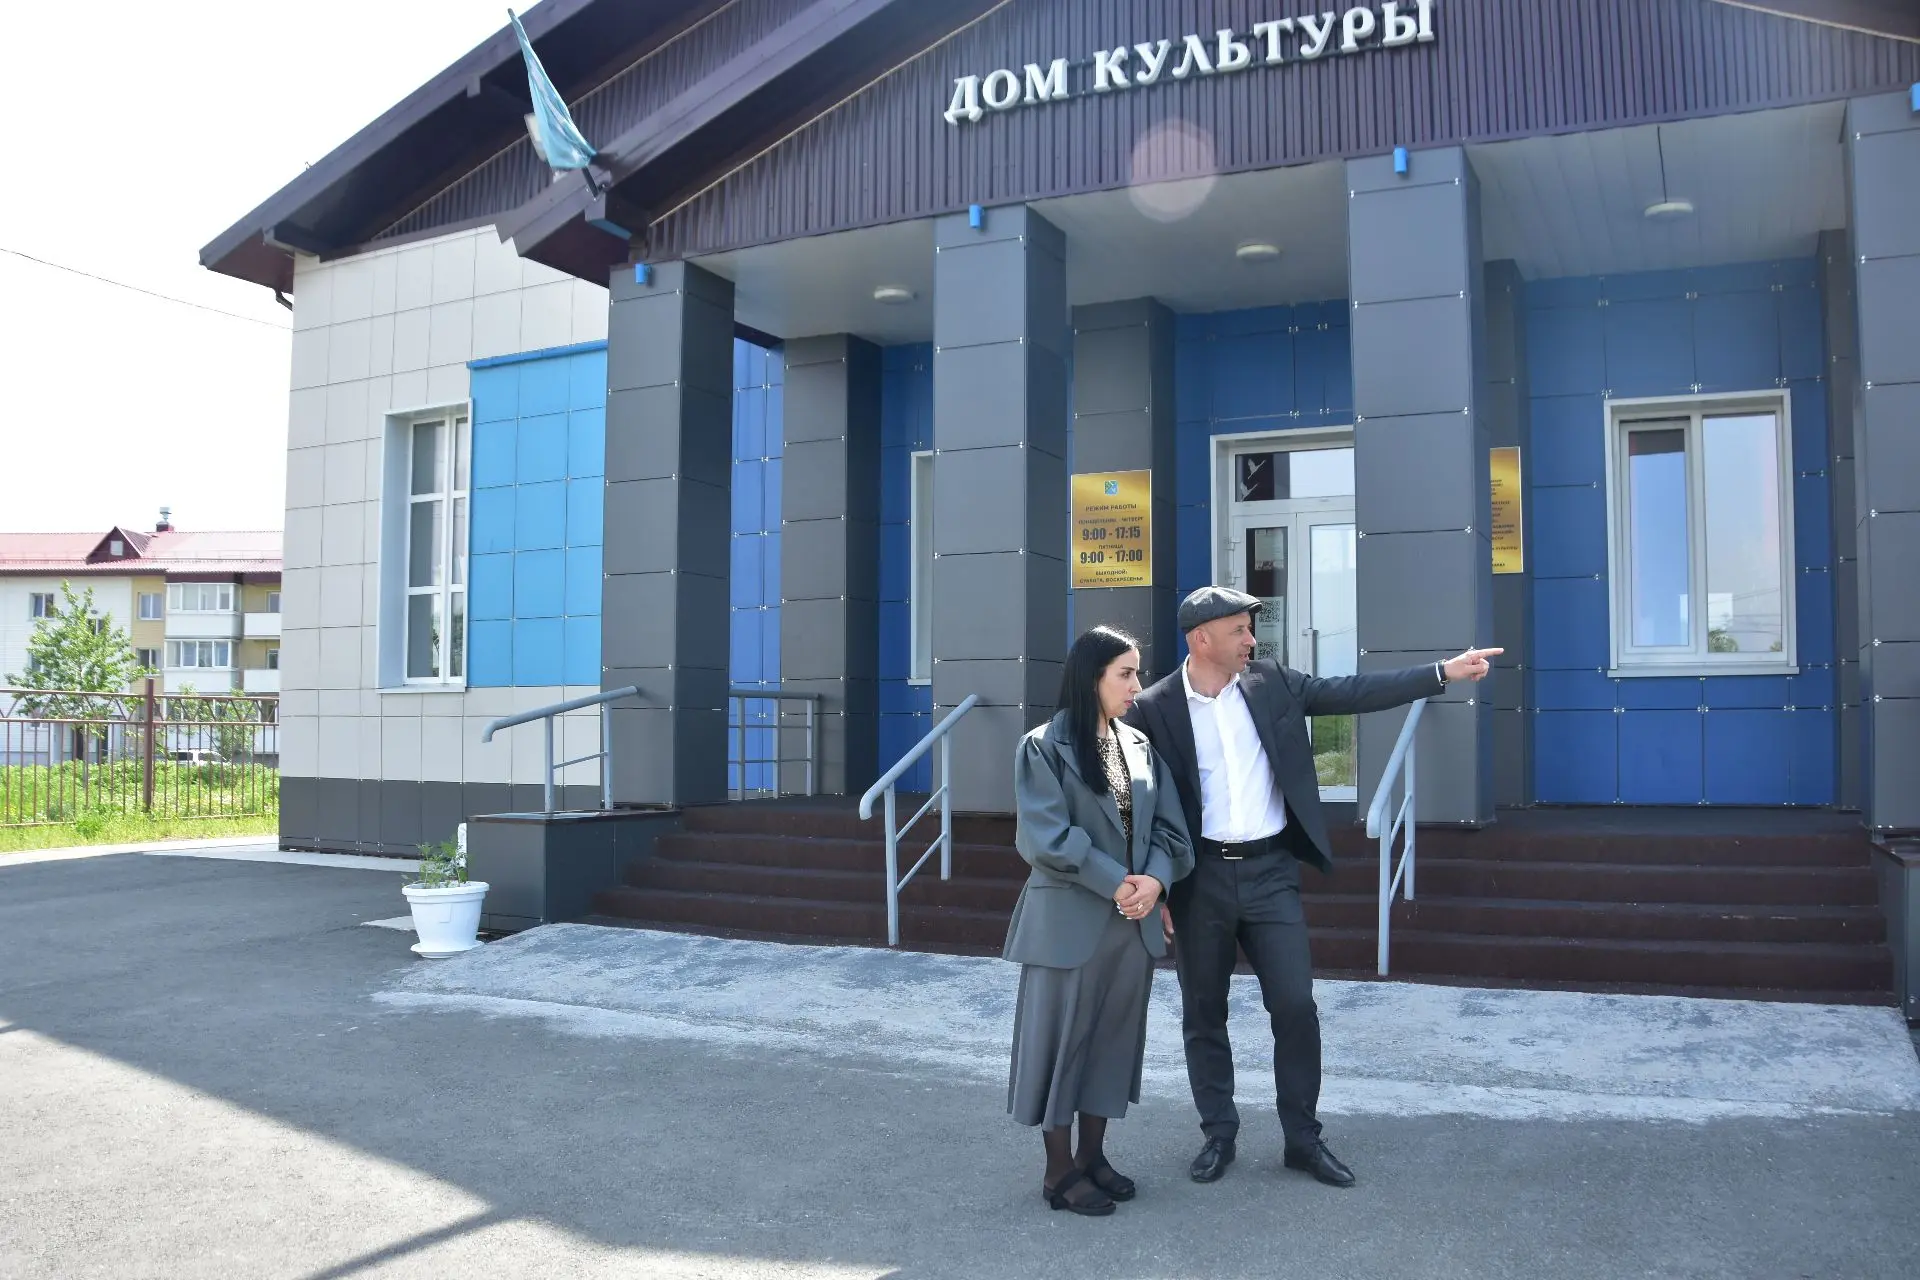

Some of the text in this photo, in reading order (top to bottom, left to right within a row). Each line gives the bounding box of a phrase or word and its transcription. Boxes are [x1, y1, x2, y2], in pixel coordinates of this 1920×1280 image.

[944, 0, 1436, 126] ДОМ КУЛЬТУРЫ
[1082, 528, 1106, 540] 9:00
[1115, 526, 1140, 538] 17:15
[1080, 551, 1104, 564] 9:00
[1115, 549, 1142, 562] 17:00
